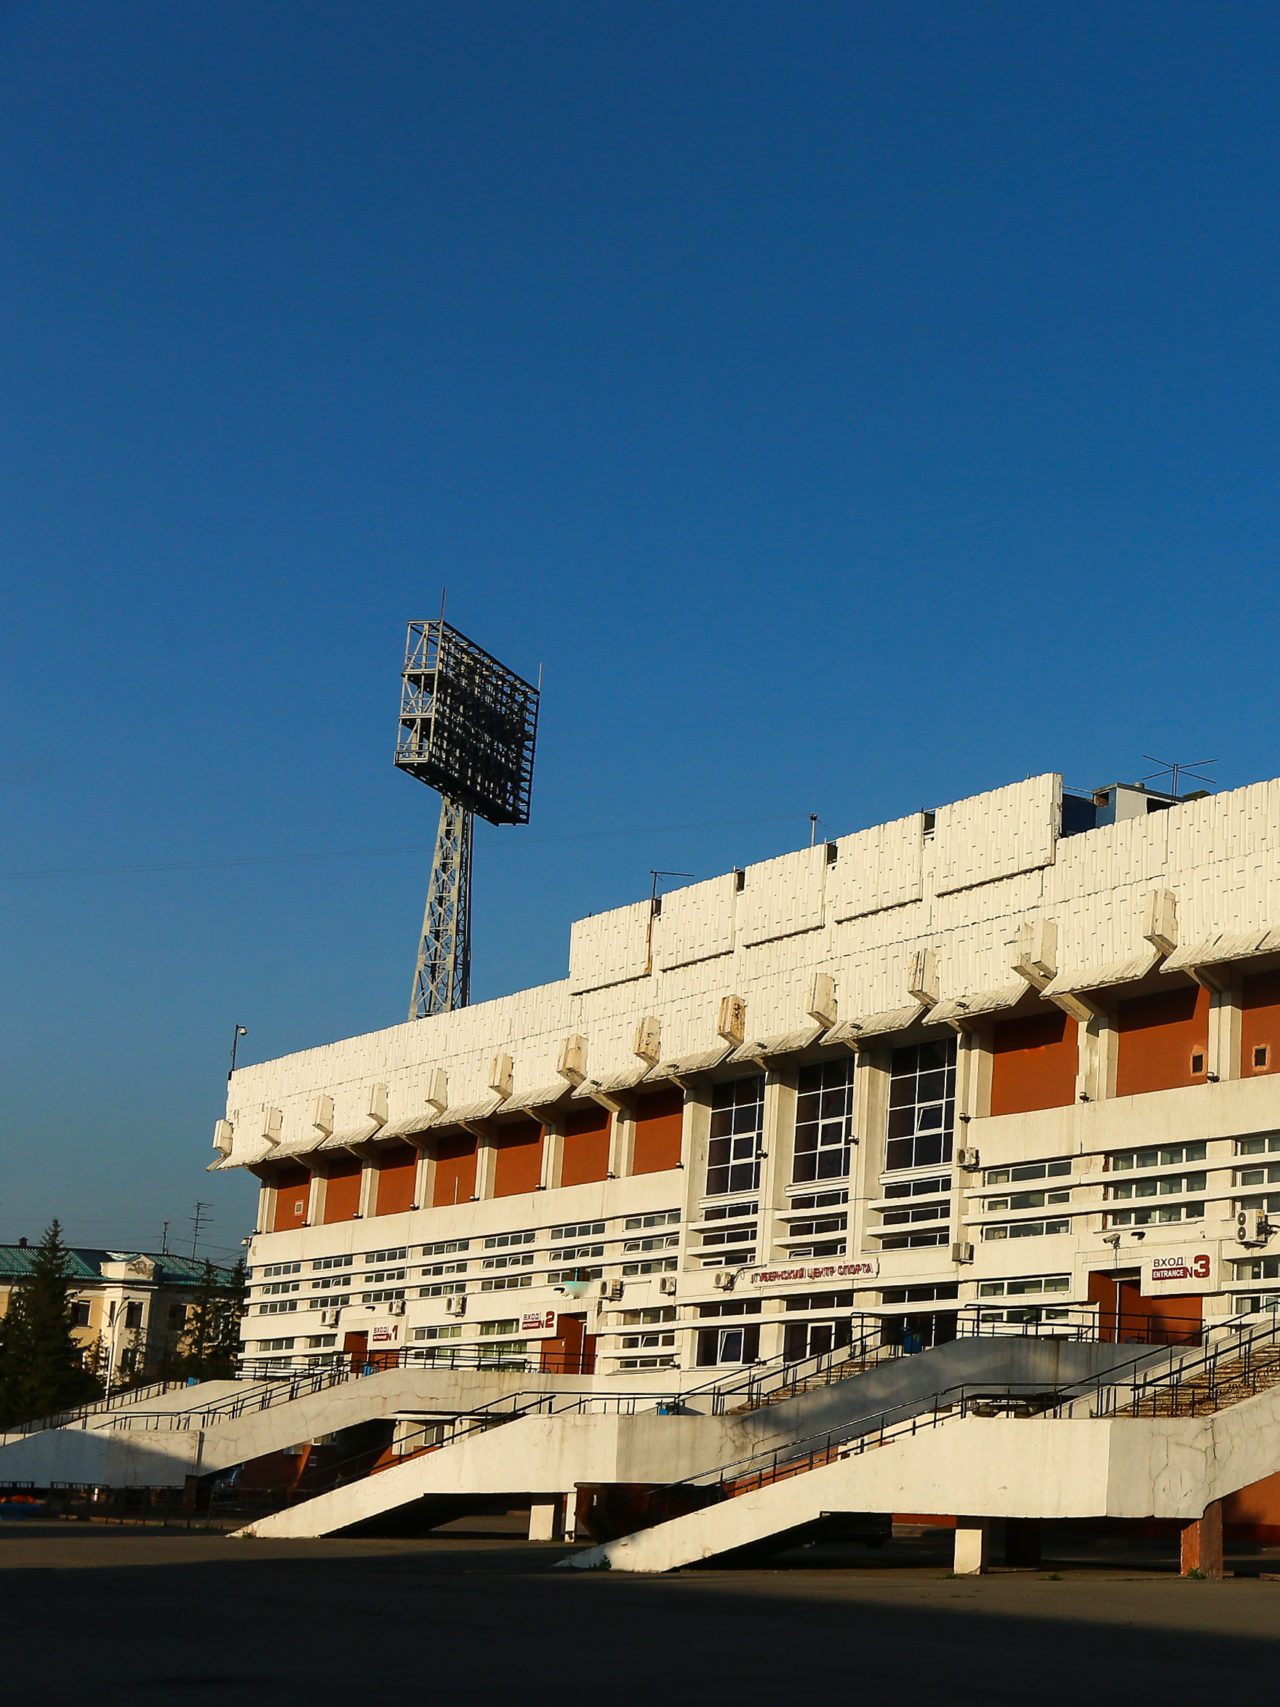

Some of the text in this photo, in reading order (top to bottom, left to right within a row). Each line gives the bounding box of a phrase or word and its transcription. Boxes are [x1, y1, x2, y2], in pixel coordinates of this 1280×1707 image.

[1153, 1256, 1184, 1268] ВХОД
[1193, 1254, 1210, 1278] 3
[807, 1265, 836, 1280] ЦЕНТР
[837, 1263, 873, 1277] СПОРТА
[1152, 1269, 1184, 1279] ENTRANCE
[545, 1311, 555, 1328] 2
[392, 1325, 398, 1341] 1
